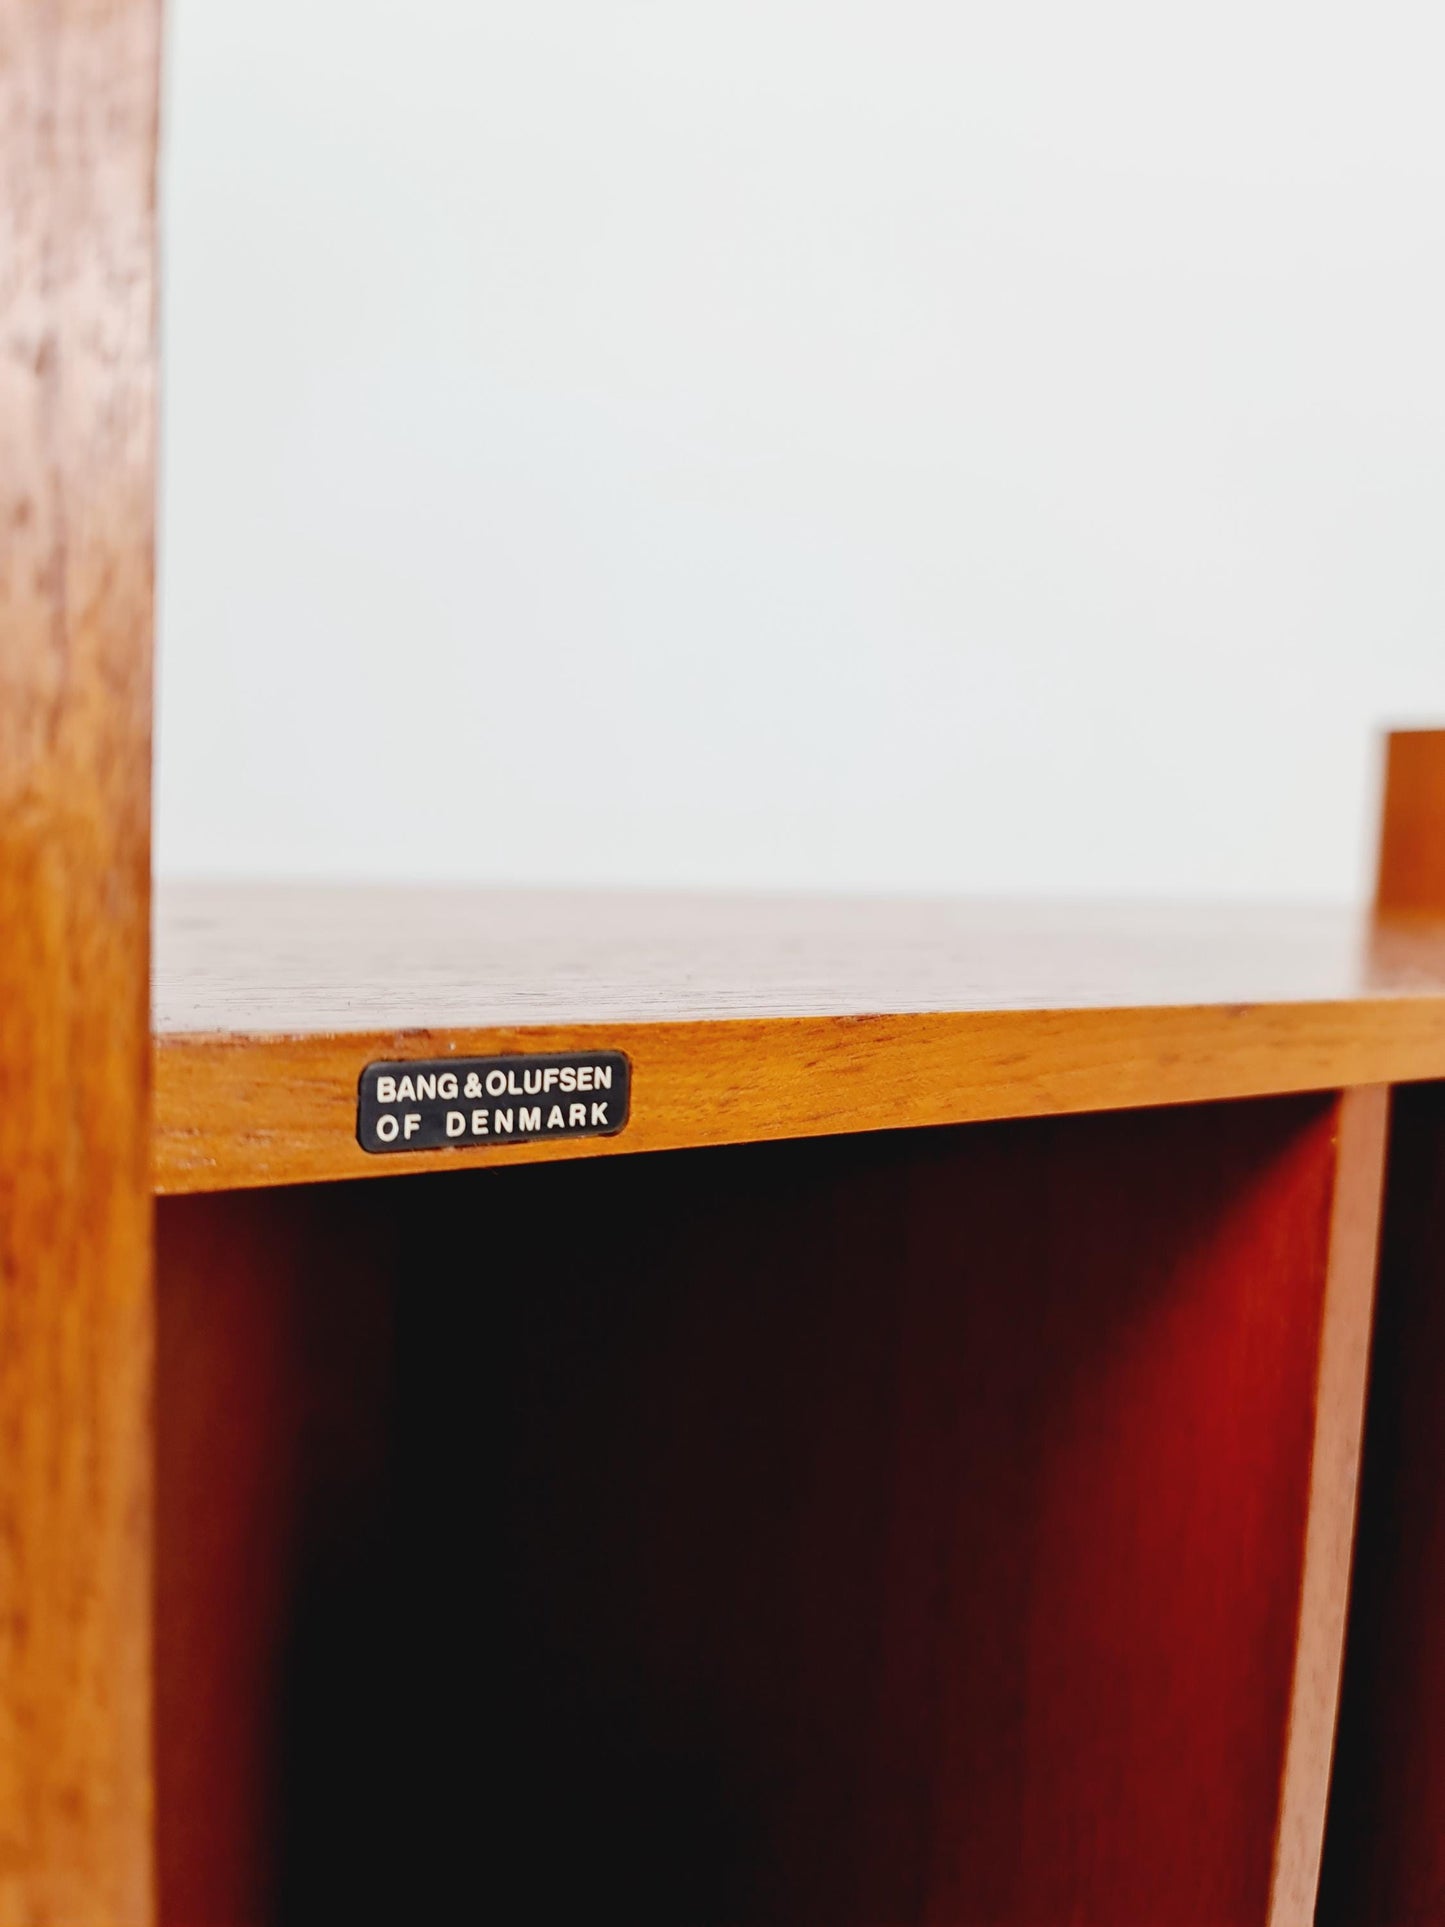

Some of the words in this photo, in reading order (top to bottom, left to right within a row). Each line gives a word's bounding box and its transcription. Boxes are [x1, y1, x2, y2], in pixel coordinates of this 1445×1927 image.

[376, 1072, 459, 1104] BANG
[485, 1065, 612, 1097] OLUFSEN
[376, 1113, 422, 1142] OF
[445, 1101, 609, 1138] DENMARK
